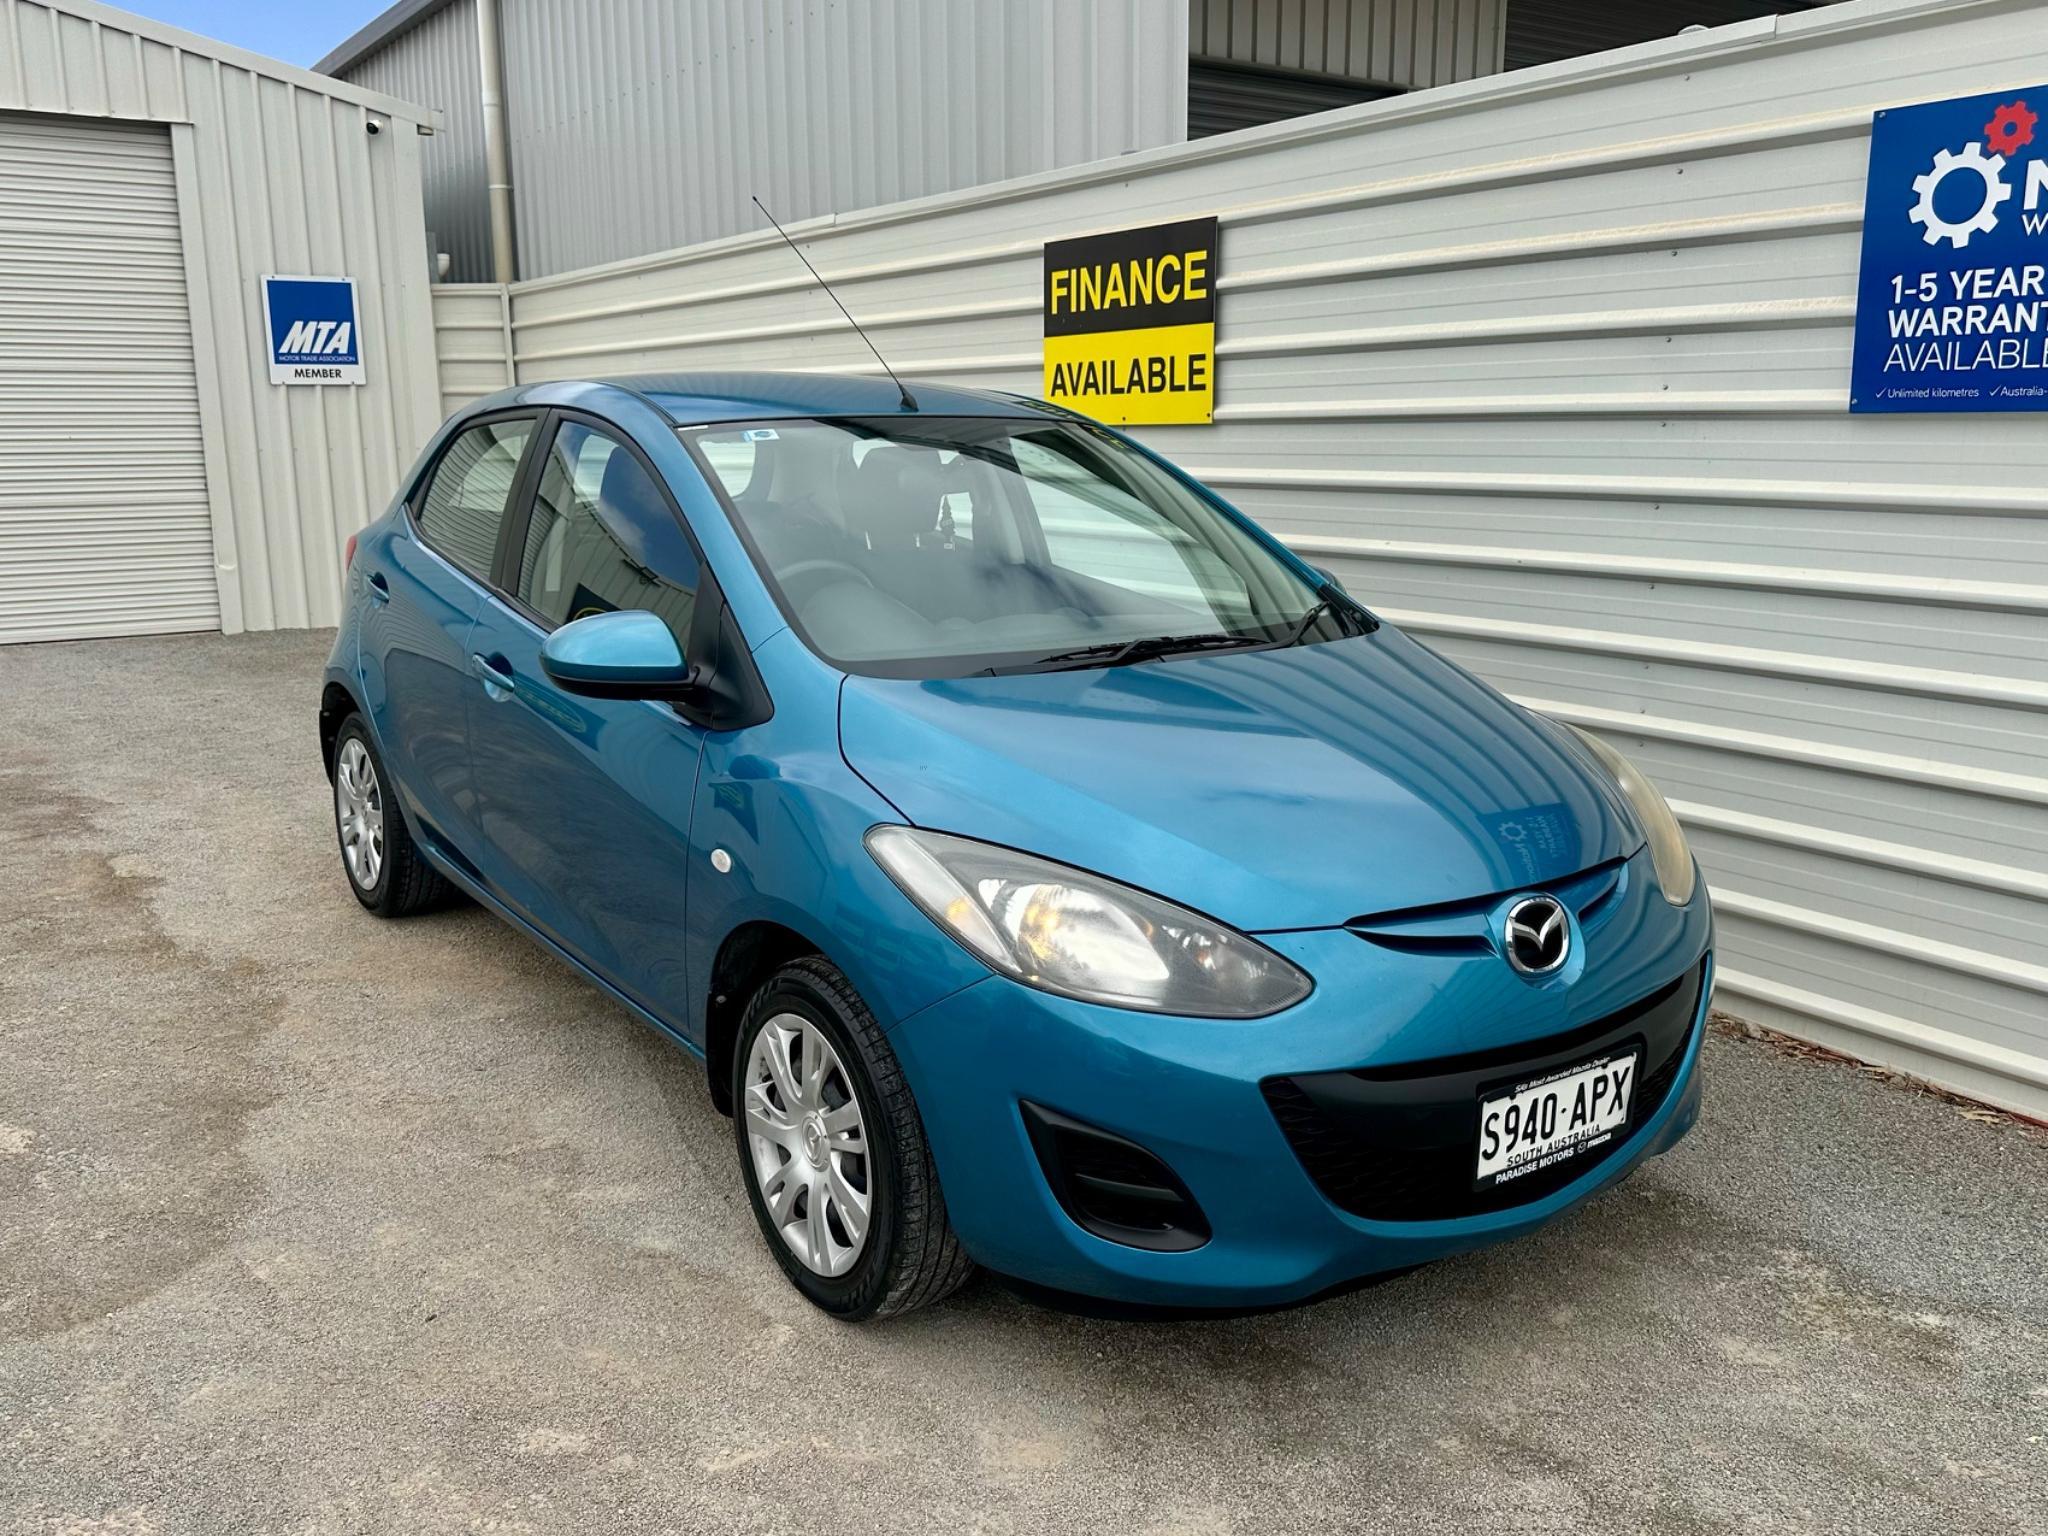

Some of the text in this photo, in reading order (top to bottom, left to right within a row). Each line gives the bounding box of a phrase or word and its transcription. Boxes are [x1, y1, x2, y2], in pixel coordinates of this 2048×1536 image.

[1051, 250, 1208, 315] FINANCE
[1890, 265, 2045, 304] 1-5 YEAR
[278, 320, 351, 354] MTA
[294, 368, 342, 378] MEMBER
[1050, 353, 1206, 397] AVAILABLE
[1887, 387, 1930, 399] Unlimited
[1931, 387, 1980, 398] kilometres
[1507, 1124, 1601, 1167] SOUTH AUSTRALIA
[1495, 1160, 1538, 1185] PARADISE
[1539, 1147, 1574, 1169] MOTORS
